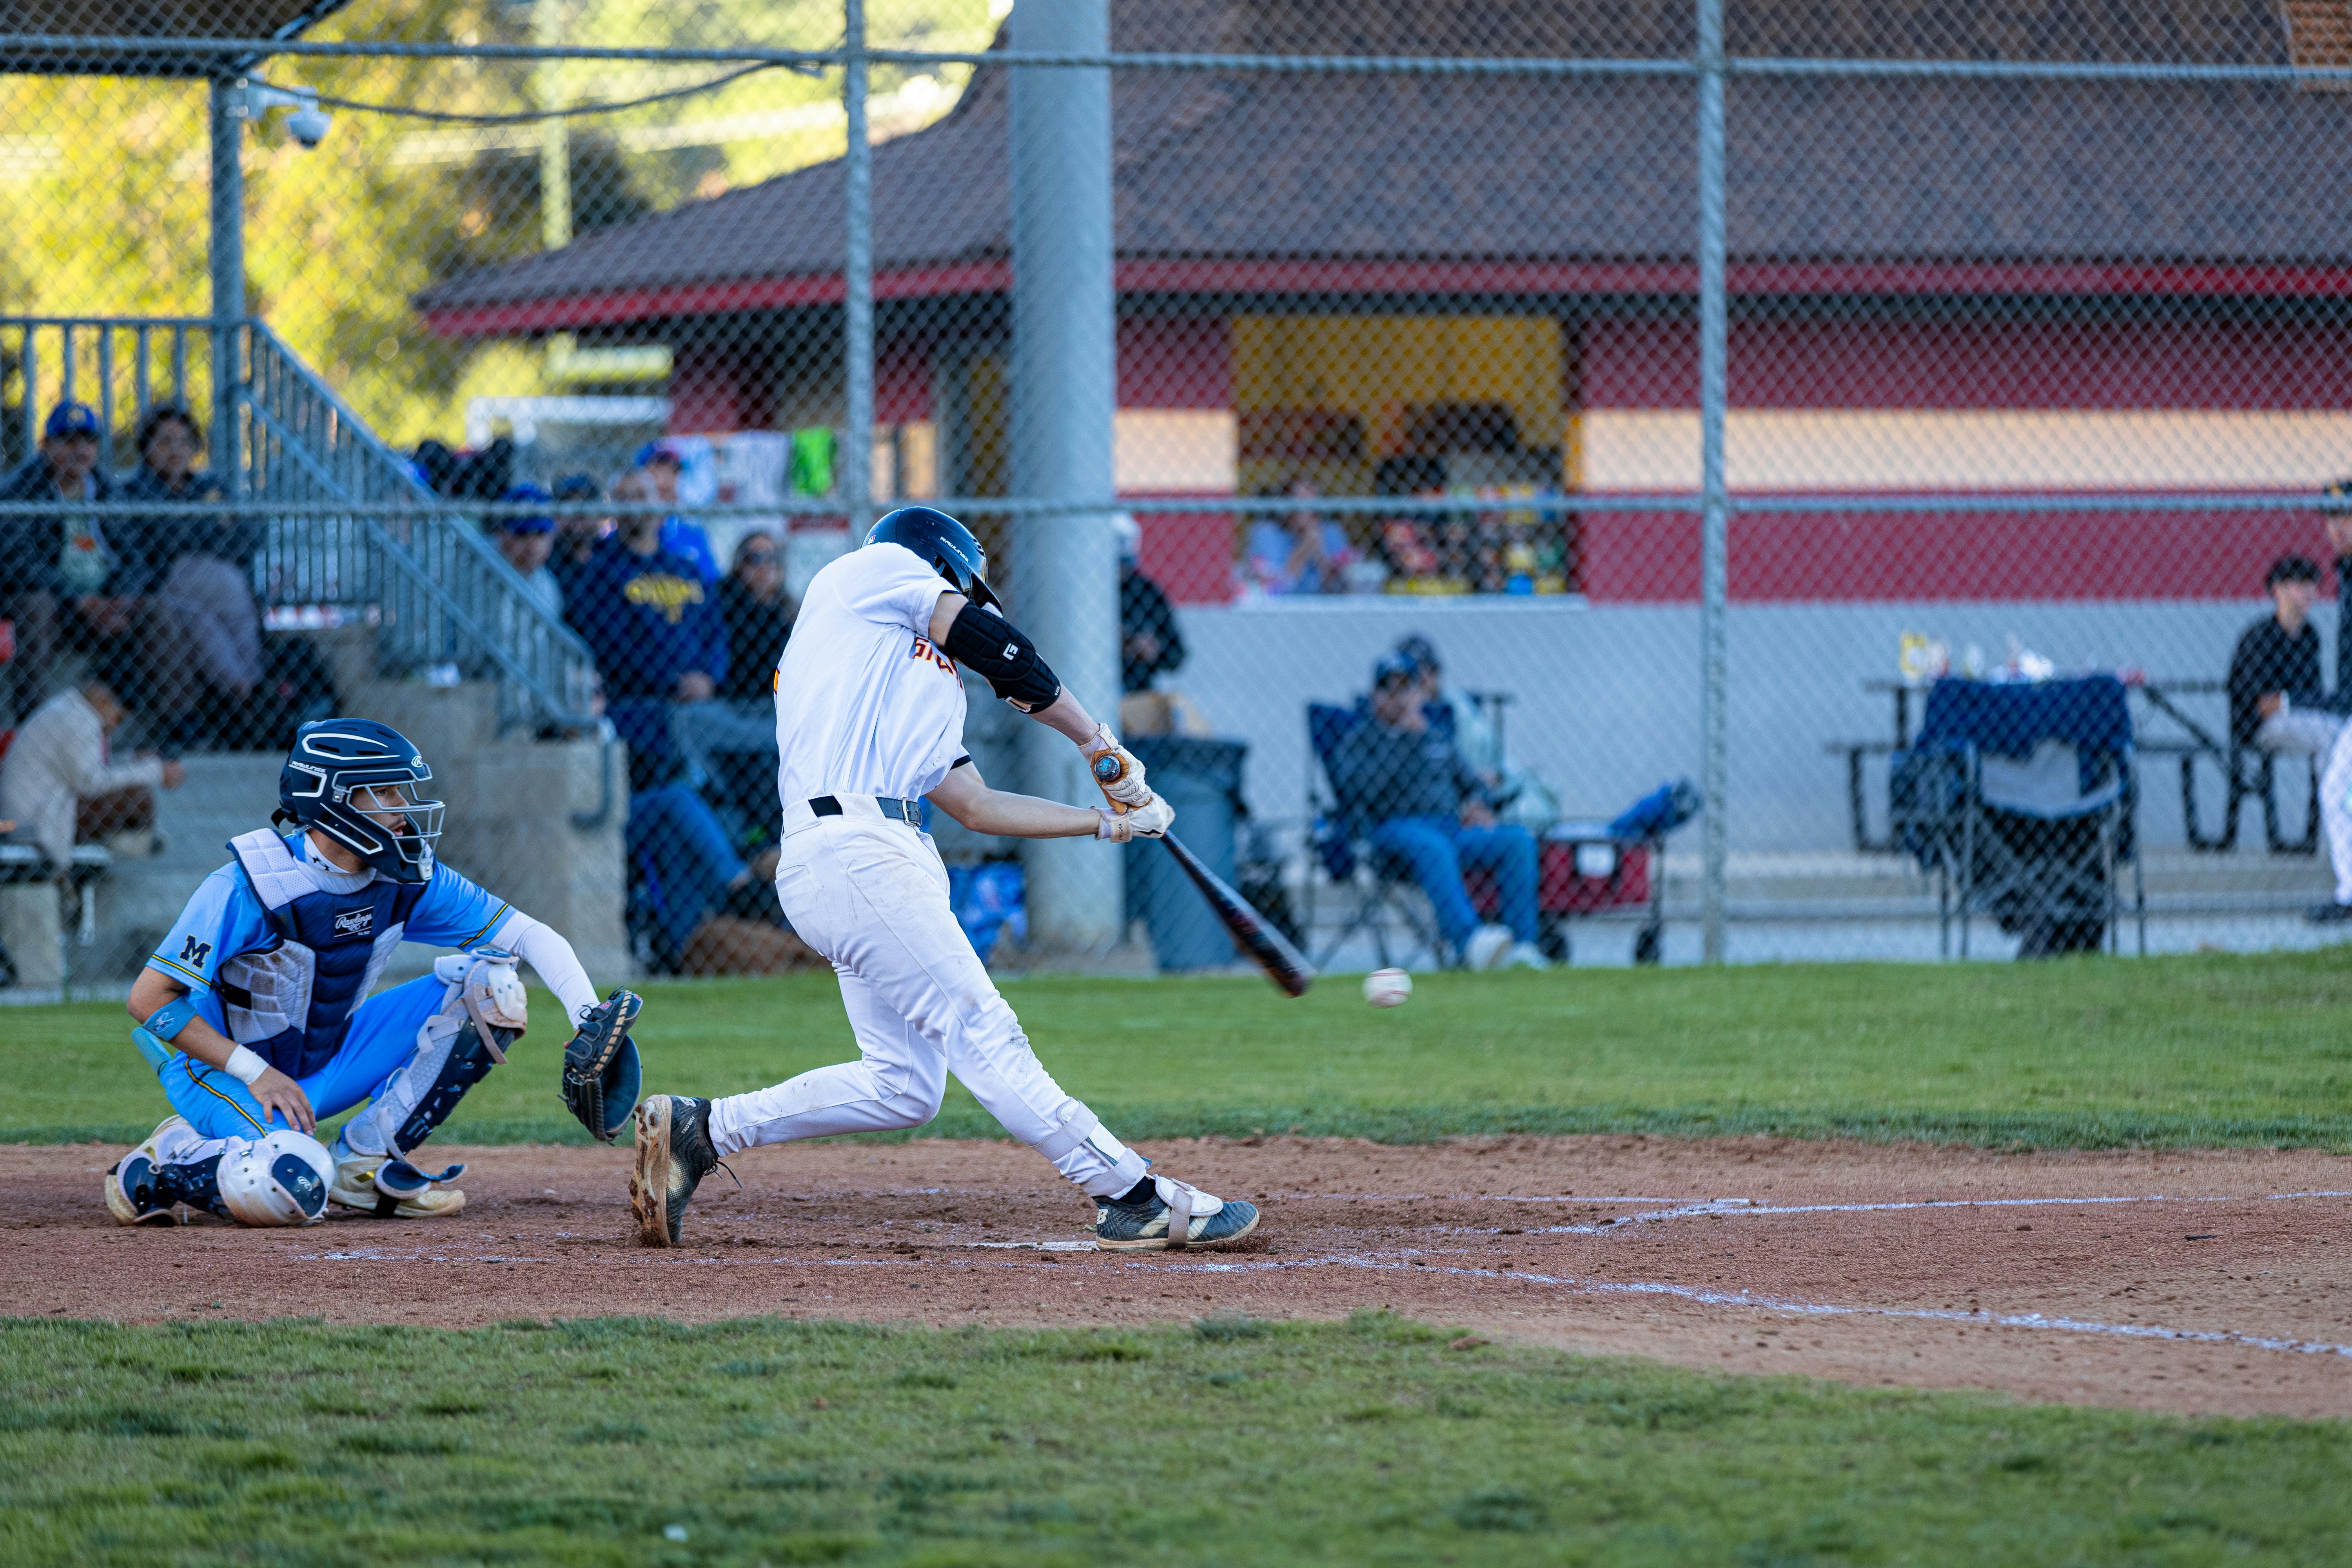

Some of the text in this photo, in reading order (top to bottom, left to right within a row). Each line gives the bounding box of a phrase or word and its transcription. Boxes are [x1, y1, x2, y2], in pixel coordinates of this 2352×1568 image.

[940, 536, 969, 563] RAWLINGS
[292, 761, 326, 773] RAWLINGS
[335, 913, 373, 929] Rawlings
[179, 934, 212, 969] M
[681, 1115, 695, 1134] FUELCELL
